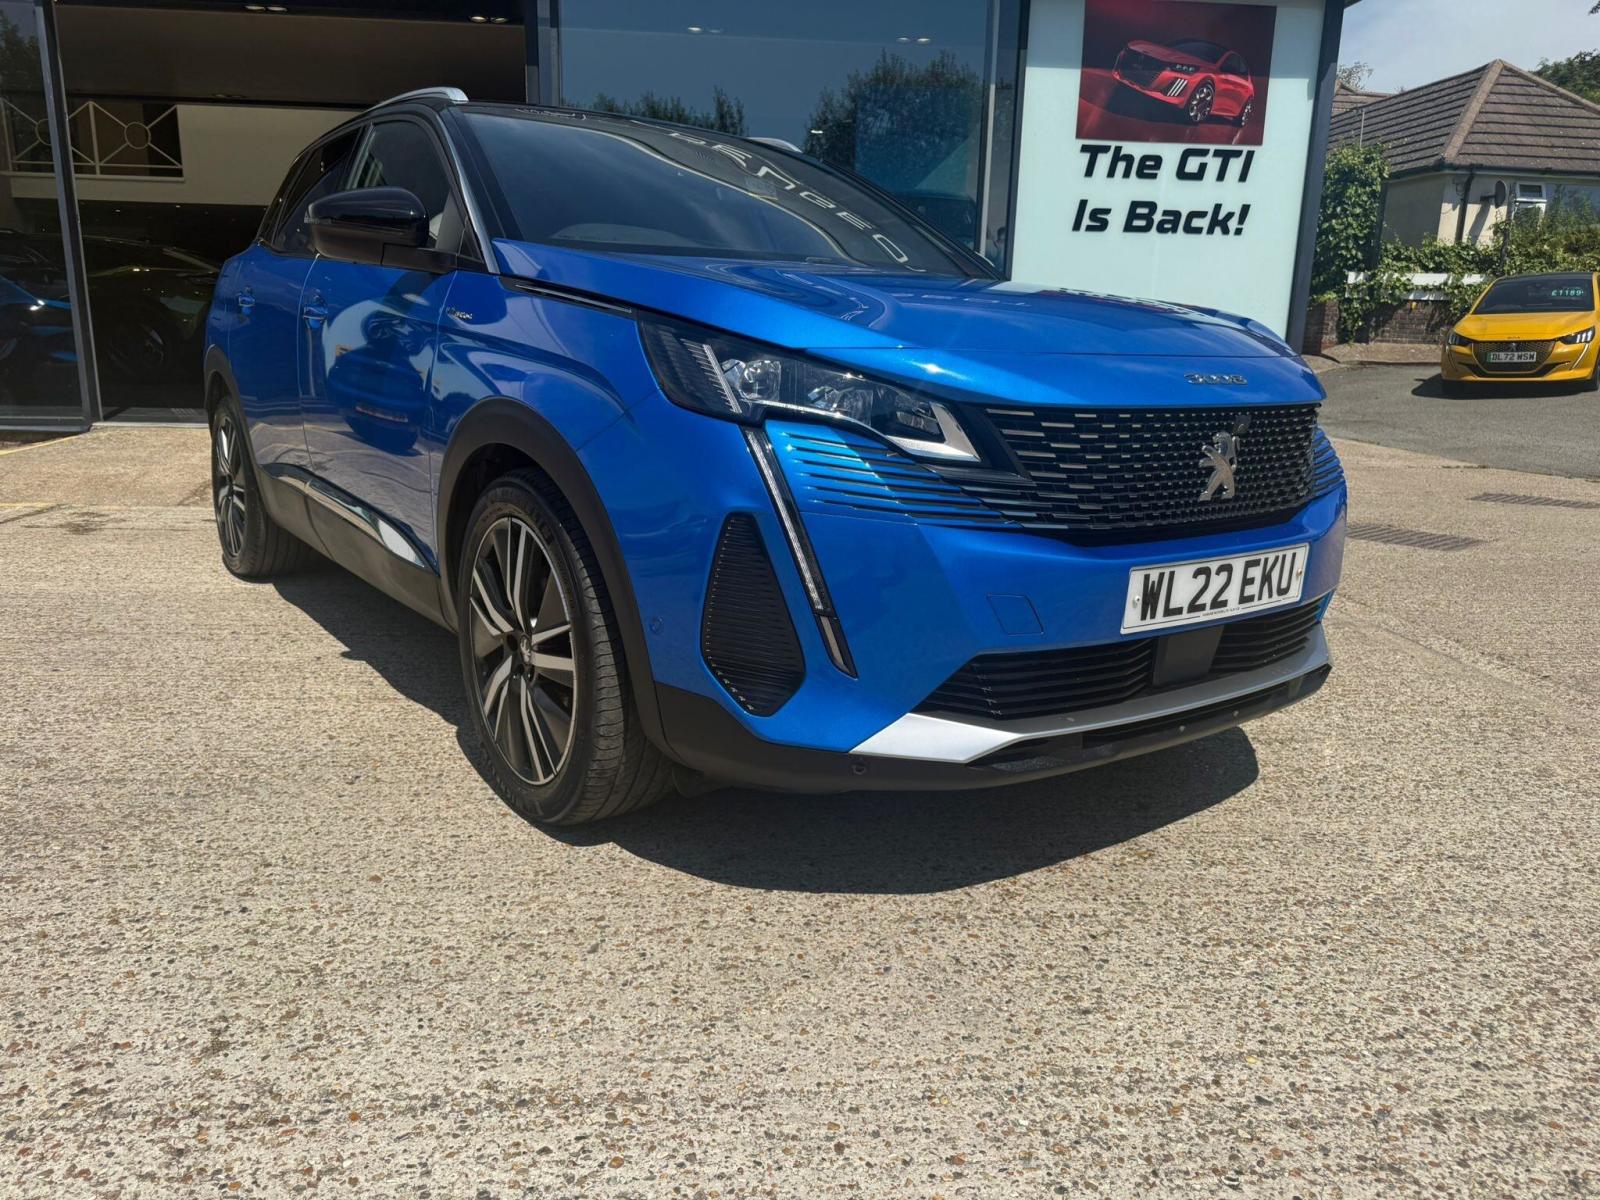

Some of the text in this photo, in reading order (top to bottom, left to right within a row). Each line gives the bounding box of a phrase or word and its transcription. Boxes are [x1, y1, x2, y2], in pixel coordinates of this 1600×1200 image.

[1079, 144, 1255, 183] The GTI
[1071, 199, 1251, 236] Is Back!
[1492, 353, 1515, 361] DL72
[1140, 552, 1297, 621] WL22 EKU
